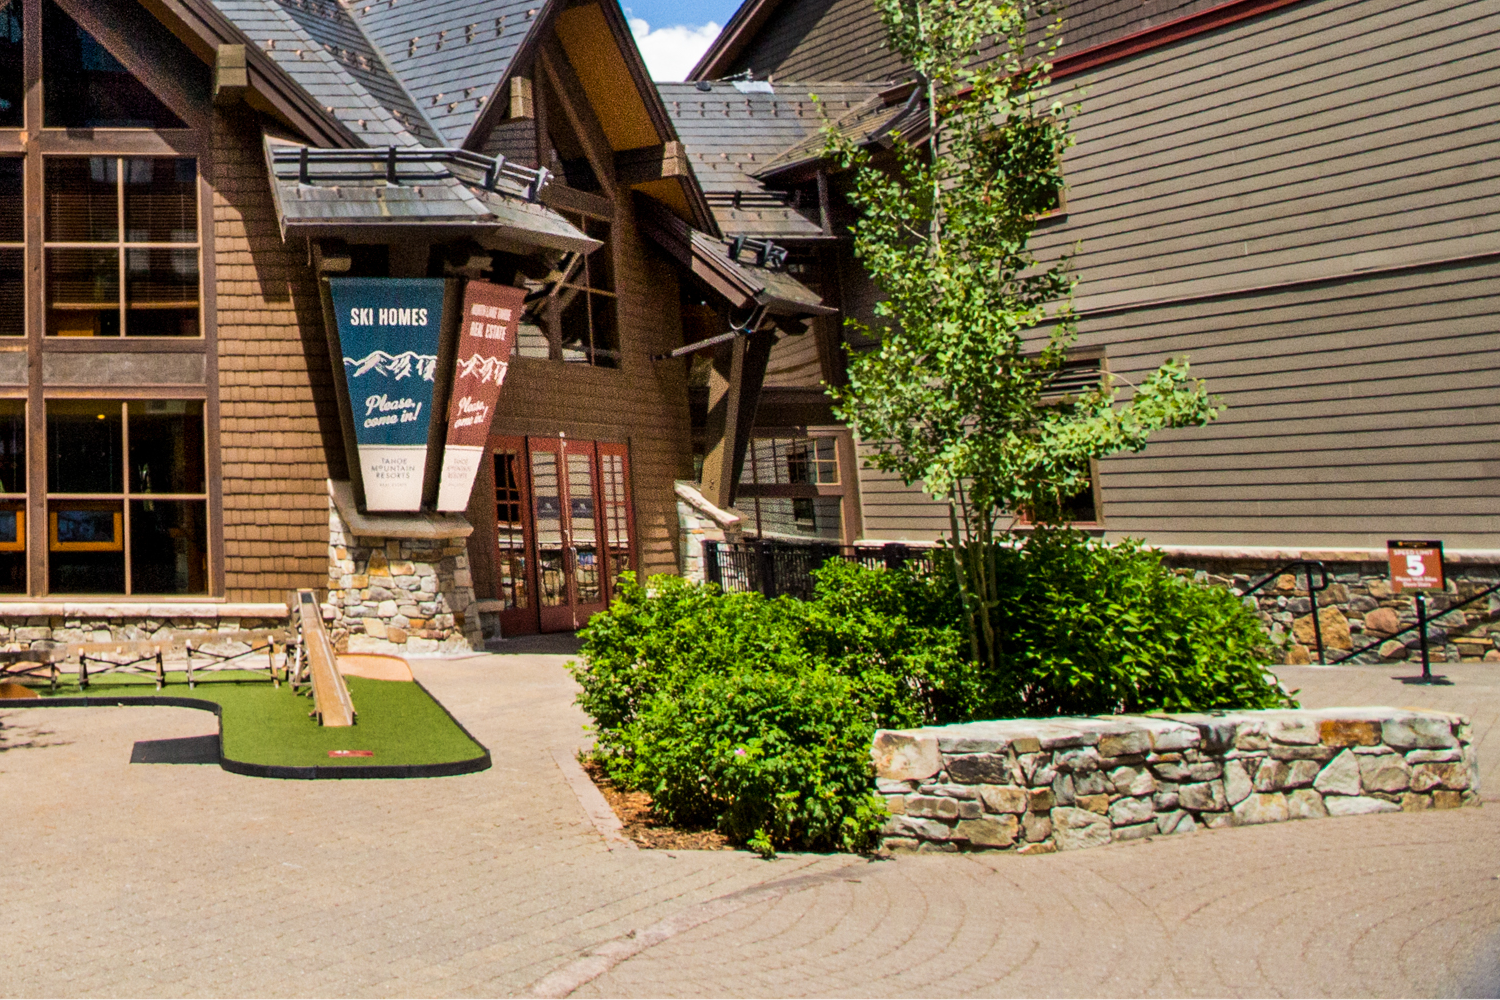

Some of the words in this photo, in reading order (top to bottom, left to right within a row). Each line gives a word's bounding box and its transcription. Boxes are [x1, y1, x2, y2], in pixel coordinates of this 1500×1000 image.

[350, 307, 374, 326] SKI
[379, 307, 428, 326] HOMES
[363, 414, 398, 429] come
[400, 401, 422, 423] in!
[381, 457, 408, 465] TAHOE
[1406, 554, 1426, 577] 5
